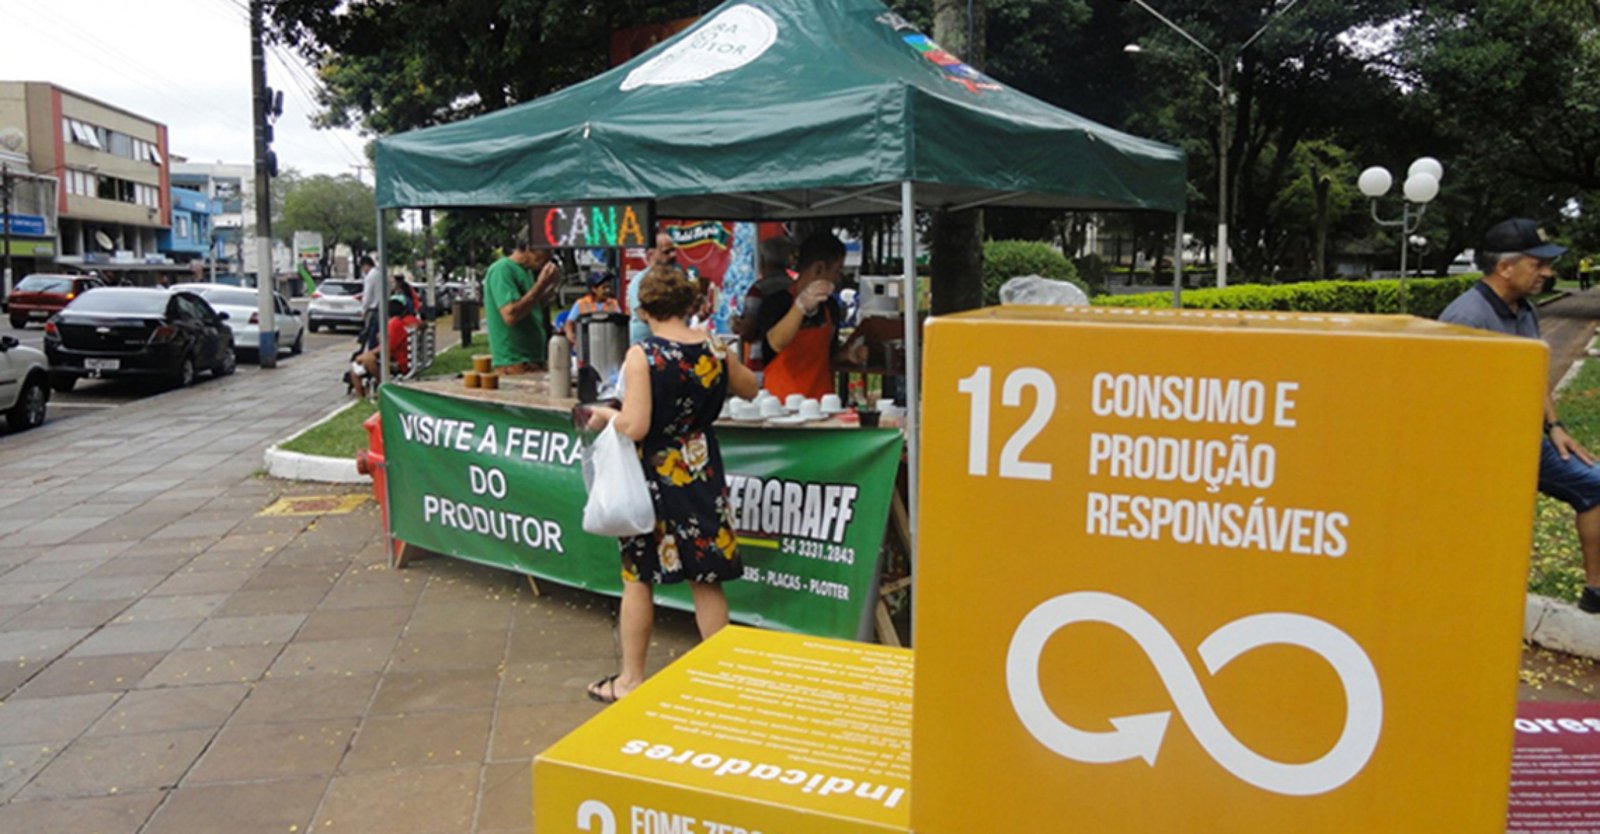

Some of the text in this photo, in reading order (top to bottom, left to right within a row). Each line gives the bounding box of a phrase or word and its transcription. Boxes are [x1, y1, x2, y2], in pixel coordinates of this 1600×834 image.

[544, 206, 644, 246] CANA
[957, 365, 1057, 481] 12
[1091, 372, 1300, 428] CONSUMO E
[400, 413, 582, 466] VISITE A FEIRA
[1088, 433, 1276, 492] PRODUÇÃO
[469, 465, 507, 499] DO
[725, 474, 858, 543] ERGRAFF
[424, 494, 563, 553] PRODUTOR
[782, 538, 797, 553] 54
[1086, 492, 1350, 558] RESPONSÁVEIS
[742, 565, 759, 582] ERS
[767, 570, 801, 590] PLACAS
[809, 578, 850, 601] PLOTTER
[620, 738, 905, 810] Indicadores
